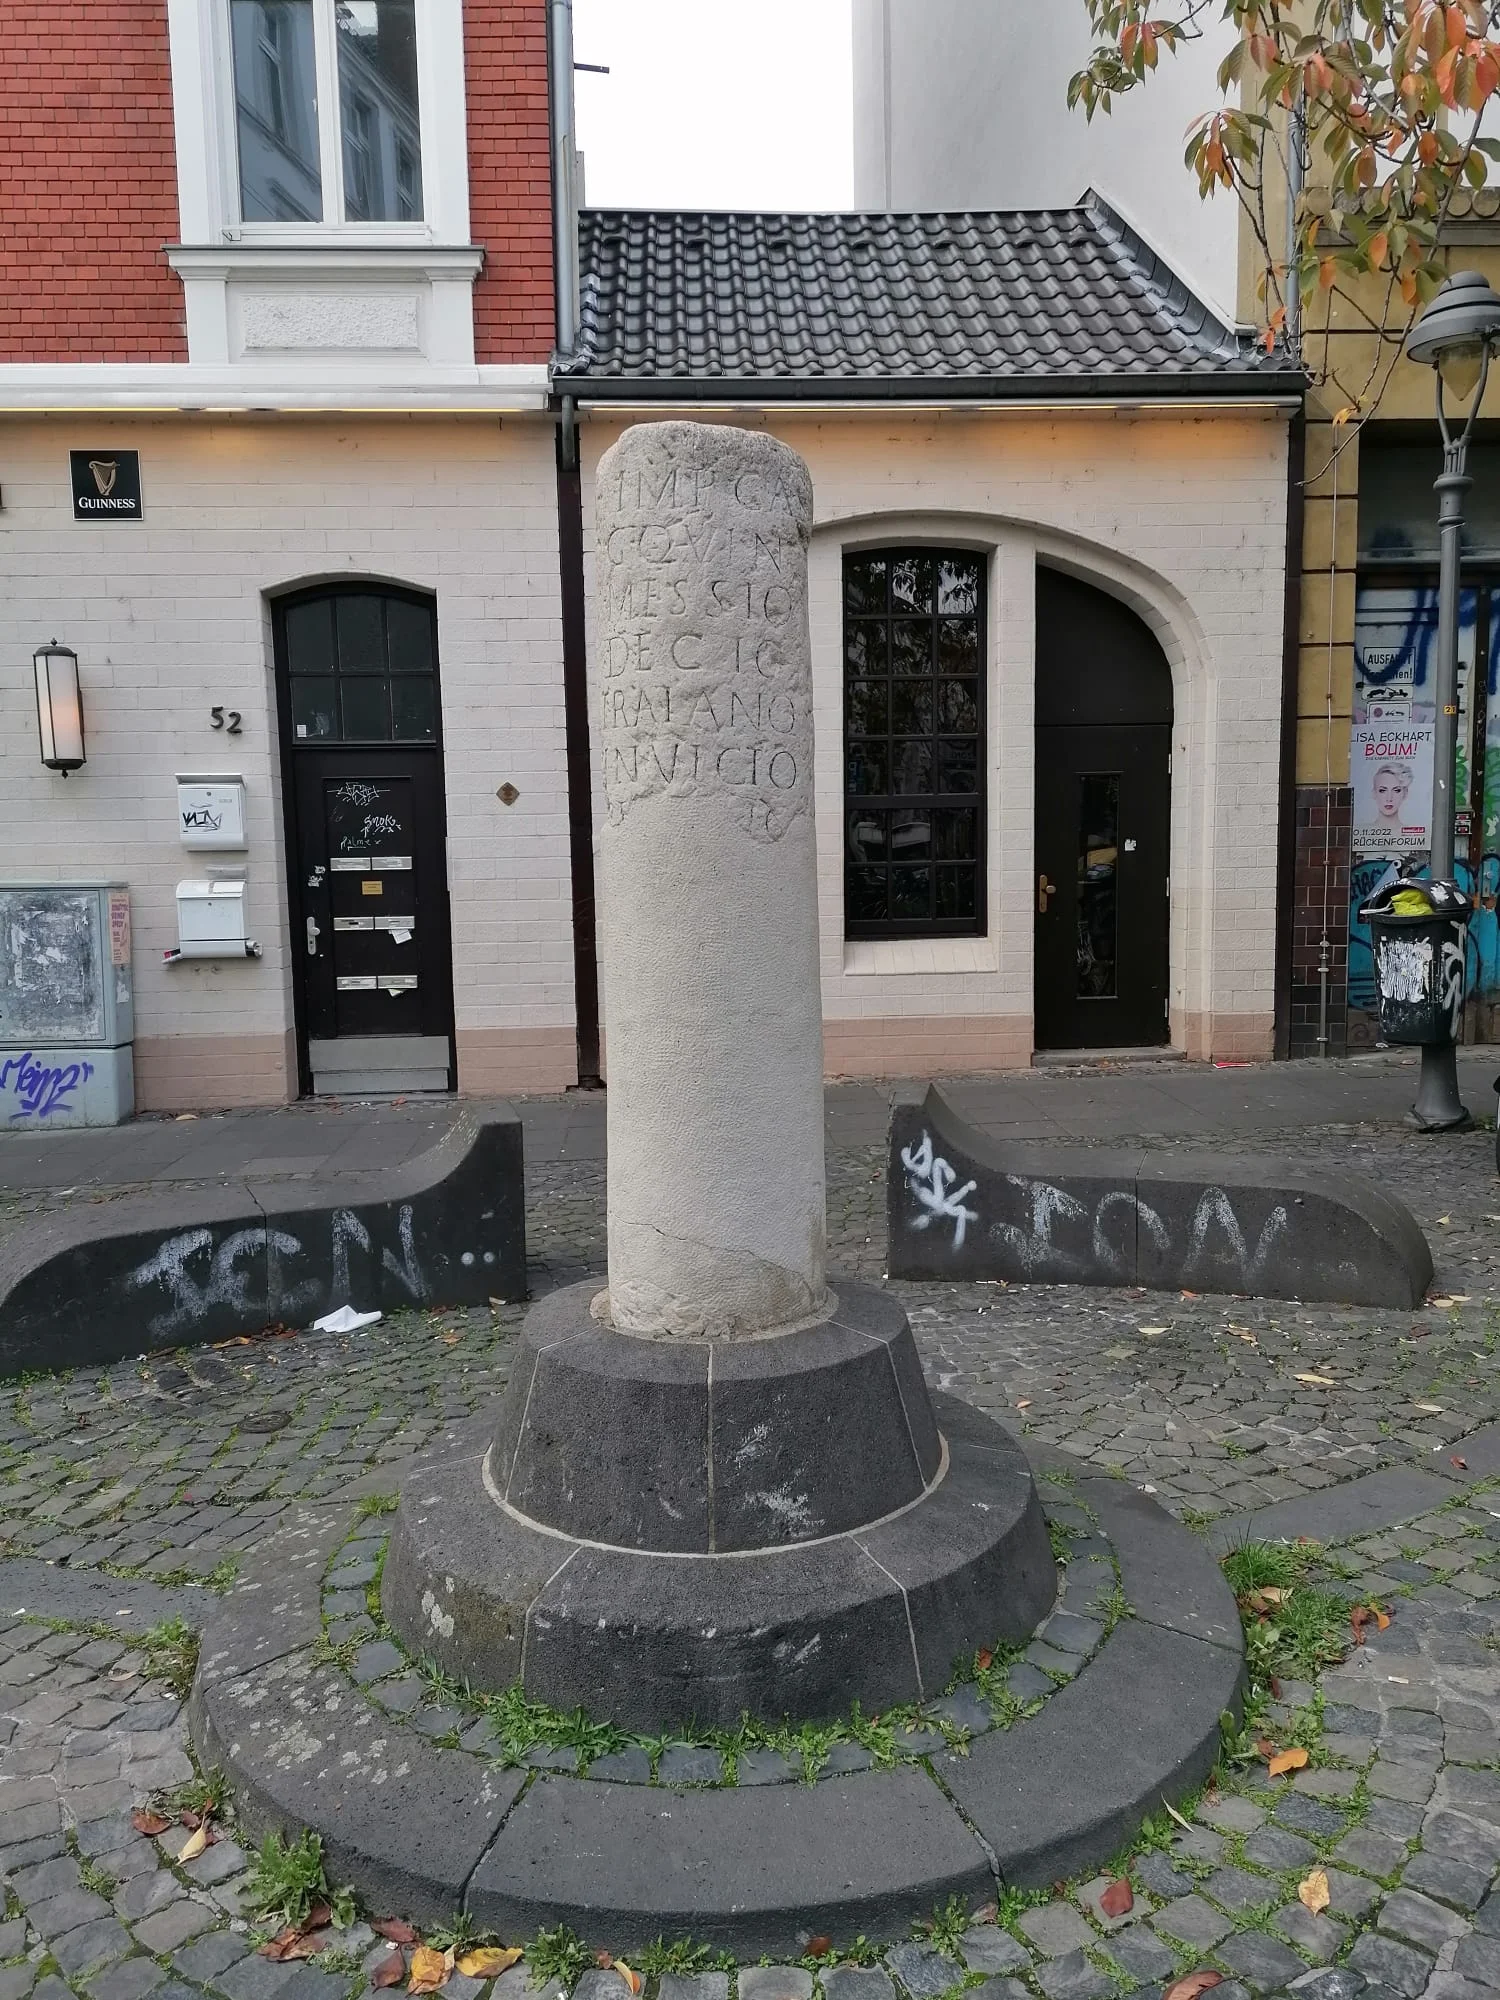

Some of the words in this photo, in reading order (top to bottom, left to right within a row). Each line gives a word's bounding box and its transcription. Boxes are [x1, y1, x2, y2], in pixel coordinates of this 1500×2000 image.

[78, 496, 136, 509] GUINNESS
[209, 706, 242, 734] 52
[1379, 731, 1432, 742] ECKHART
[1364, 742, 1418, 757] BOUM!
